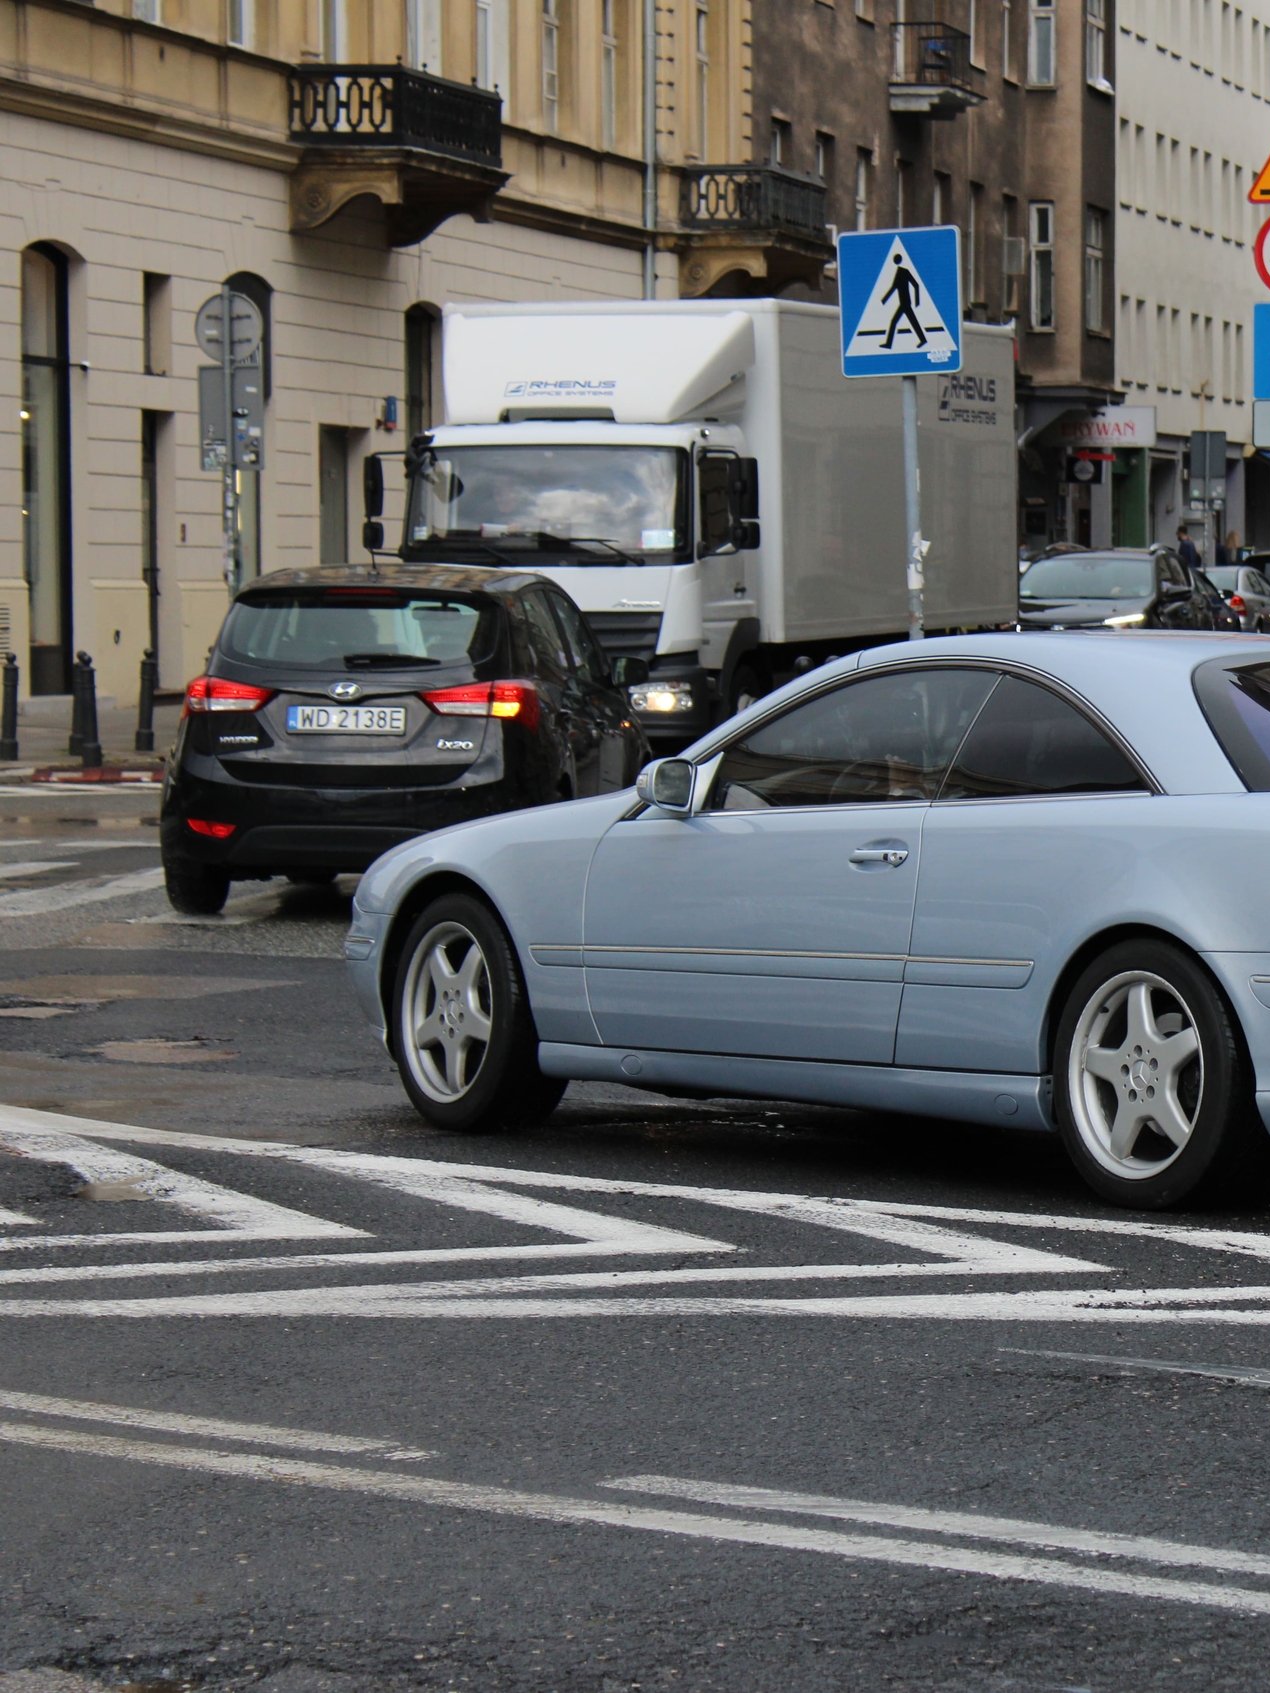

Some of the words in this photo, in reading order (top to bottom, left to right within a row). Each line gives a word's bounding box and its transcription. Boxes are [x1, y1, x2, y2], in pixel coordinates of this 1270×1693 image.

[529, 380, 617, 389] RHENUS
[951, 375, 996, 403] RHENUS
[301, 708, 330, 727] WD
[337, 710, 403, 730] 2138E
